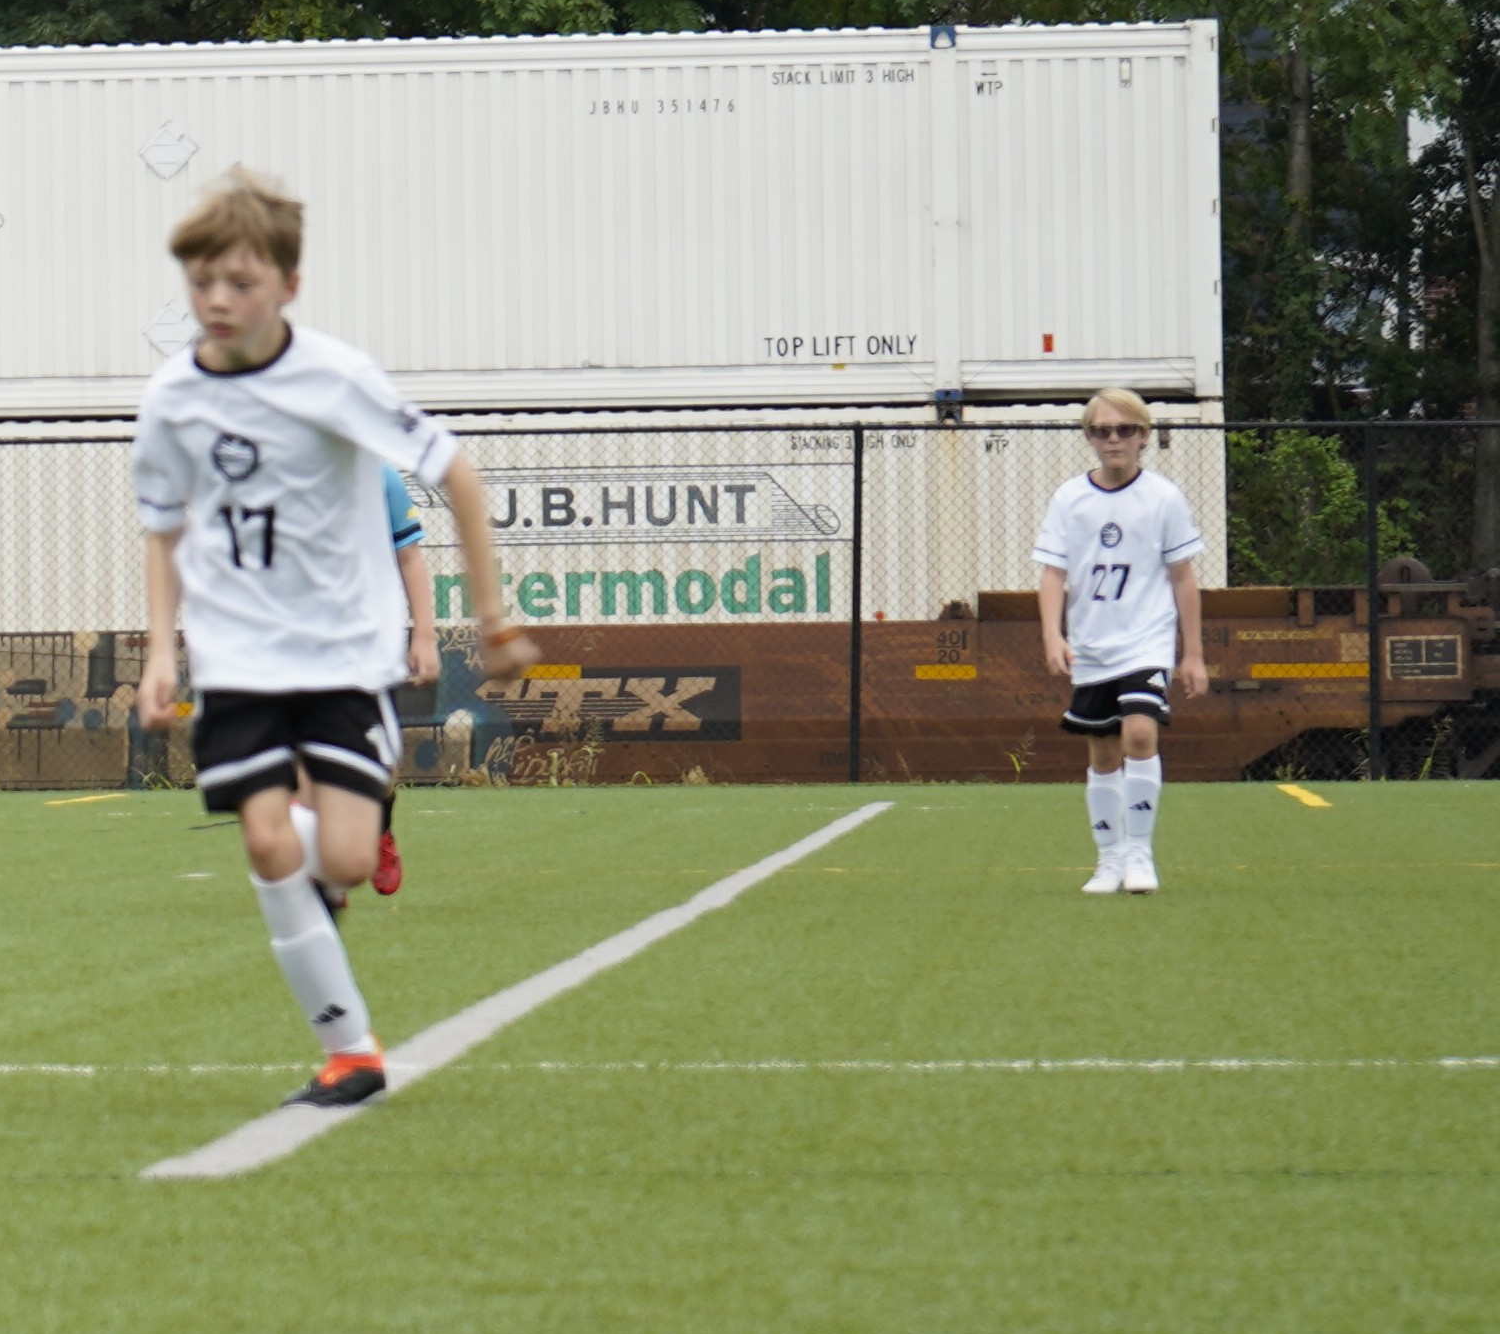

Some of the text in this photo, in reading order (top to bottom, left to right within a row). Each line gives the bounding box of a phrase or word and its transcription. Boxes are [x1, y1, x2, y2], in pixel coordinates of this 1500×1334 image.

[772, 68, 914, 86] STACK LIMIT 3 HIGH
[975, 80, 1003, 97] WTP
[589, 98, 735, 116] JBHU 351476
[764, 334, 917, 357] TOP LIFT ONLY
[218, 505, 276, 569] 17
[1091, 563, 1132, 602] 27
